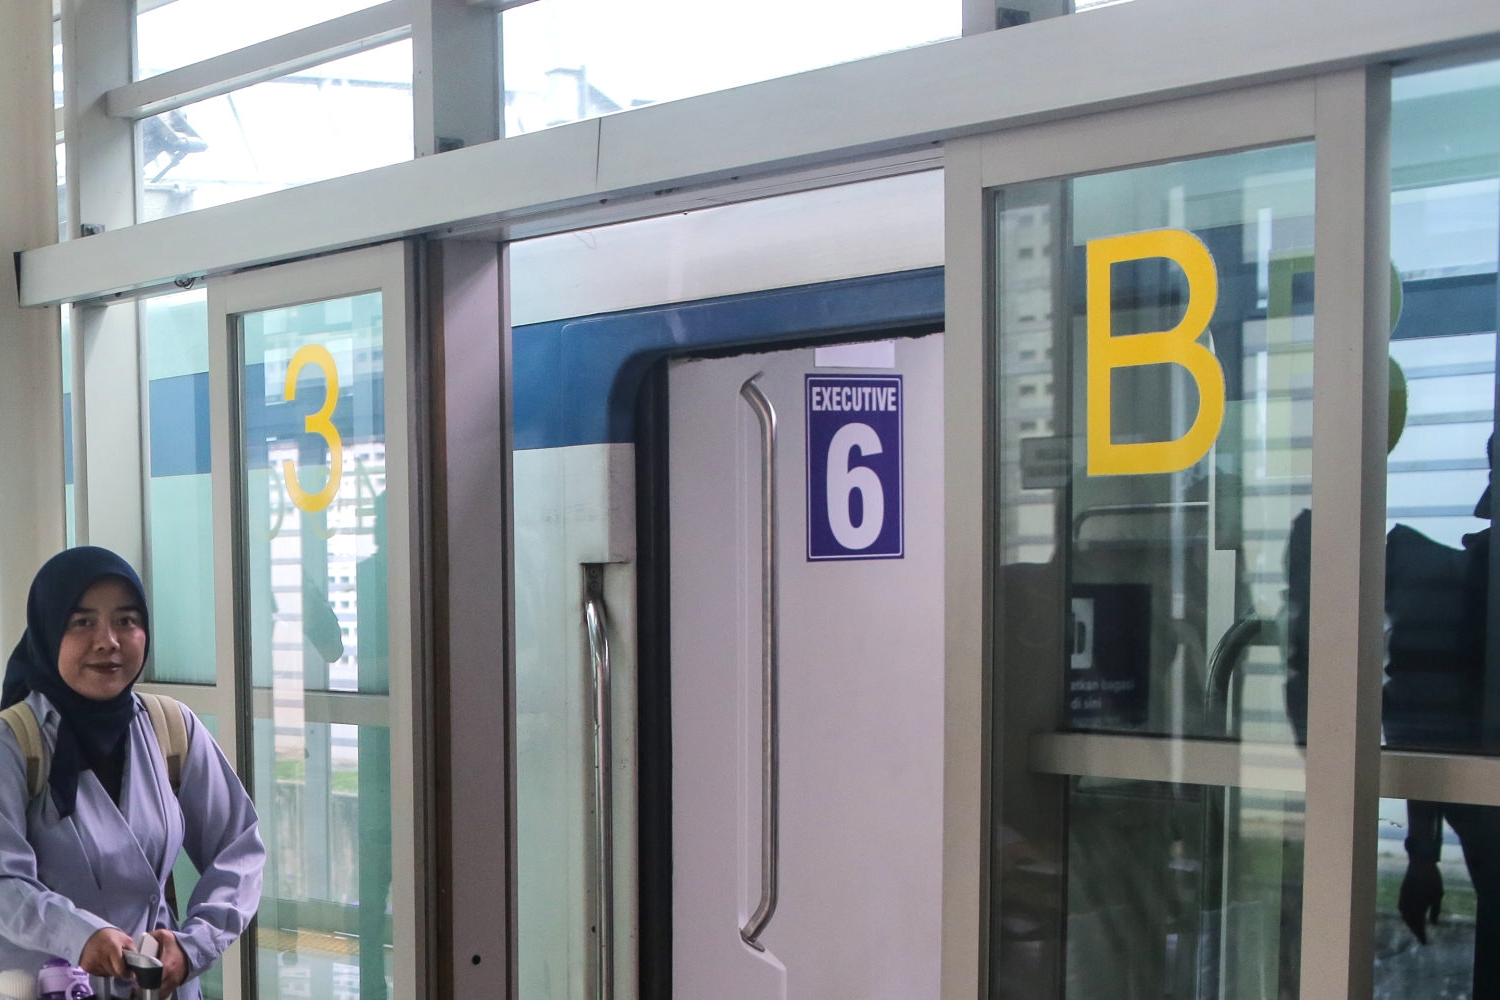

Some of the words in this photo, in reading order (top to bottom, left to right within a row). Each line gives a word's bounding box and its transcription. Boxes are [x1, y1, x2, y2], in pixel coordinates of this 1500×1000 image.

[812, 386, 897, 412] EXECUTIVE
[1086, 229, 1225, 477] B
[283, 344, 343, 513] 3
[826, 422, 885, 550] 6
